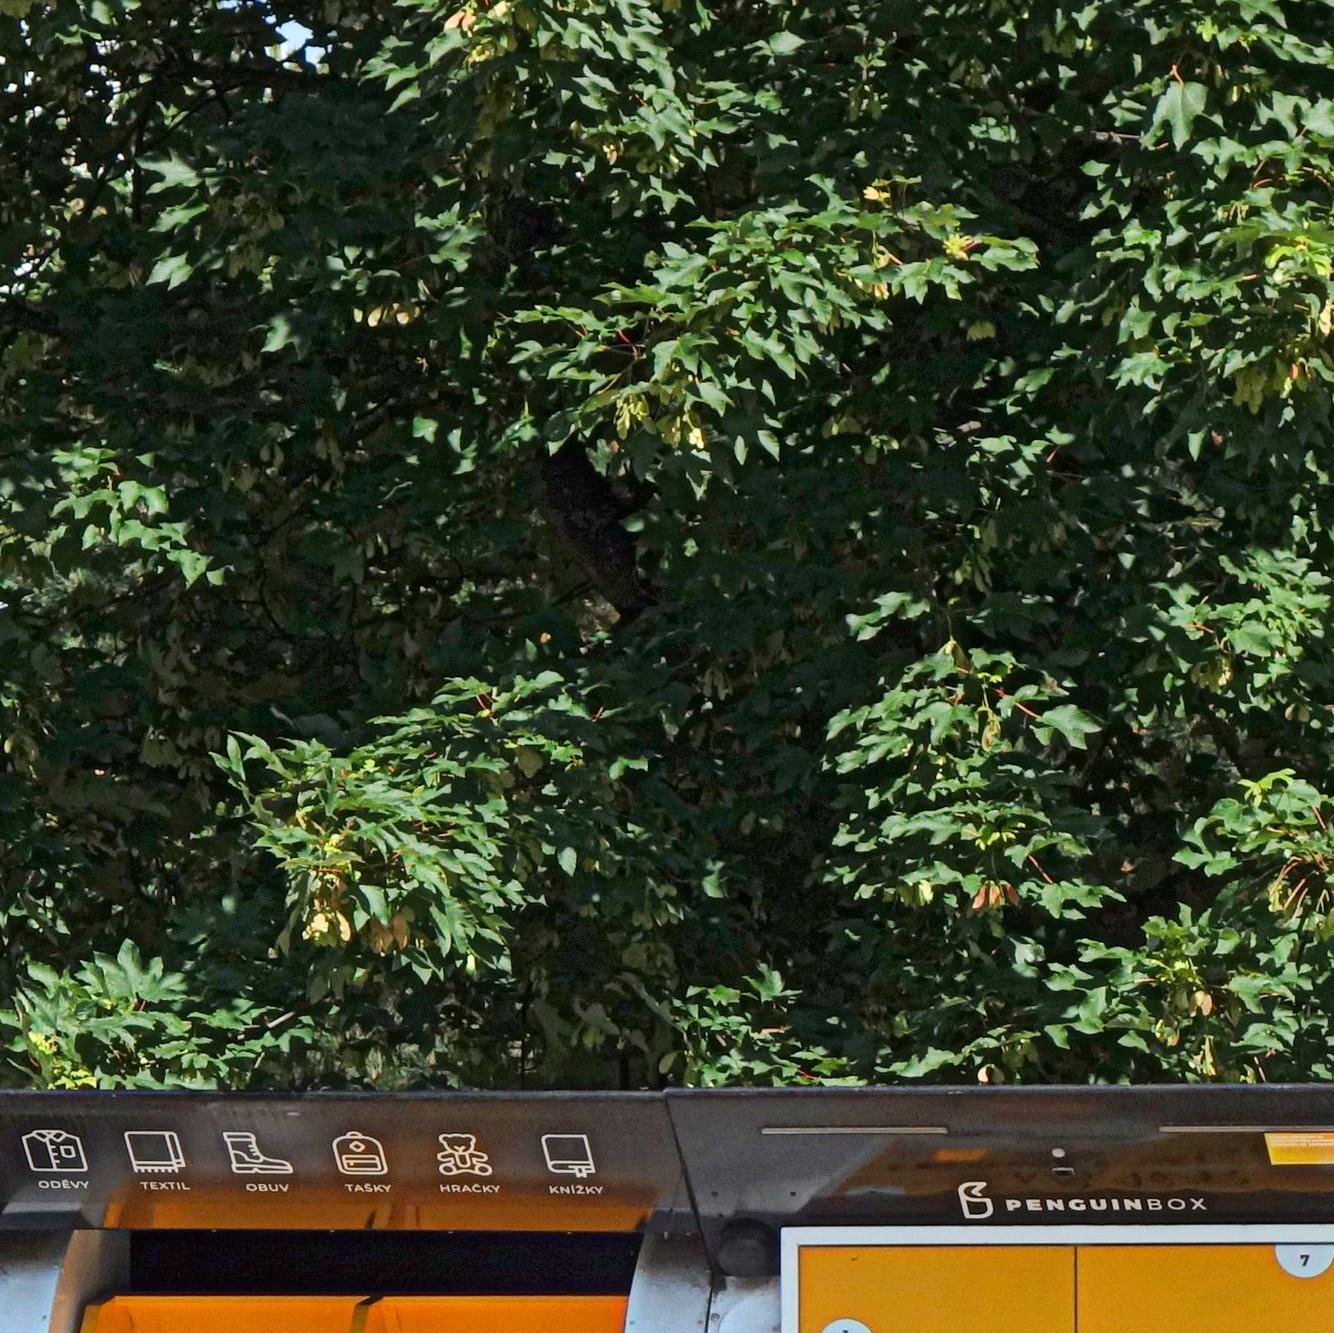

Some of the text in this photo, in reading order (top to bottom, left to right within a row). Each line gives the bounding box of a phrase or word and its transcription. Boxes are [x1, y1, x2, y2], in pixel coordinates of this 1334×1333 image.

[38, 1179, 89, 1190] ODĚVY
[140, 1181, 190, 1191] TEXTIL
[246, 1183, 289, 1192] OBUV
[344, 1183, 391, 1193] TAŠKY
[439, 1183, 500, 1194] HRAČKY
[549, 1184, 603, 1195] KNÍŽKY
[1006, 1198, 1208, 1212] PENGUINBOX
[1300, 1254, 1310, 1266] 7
